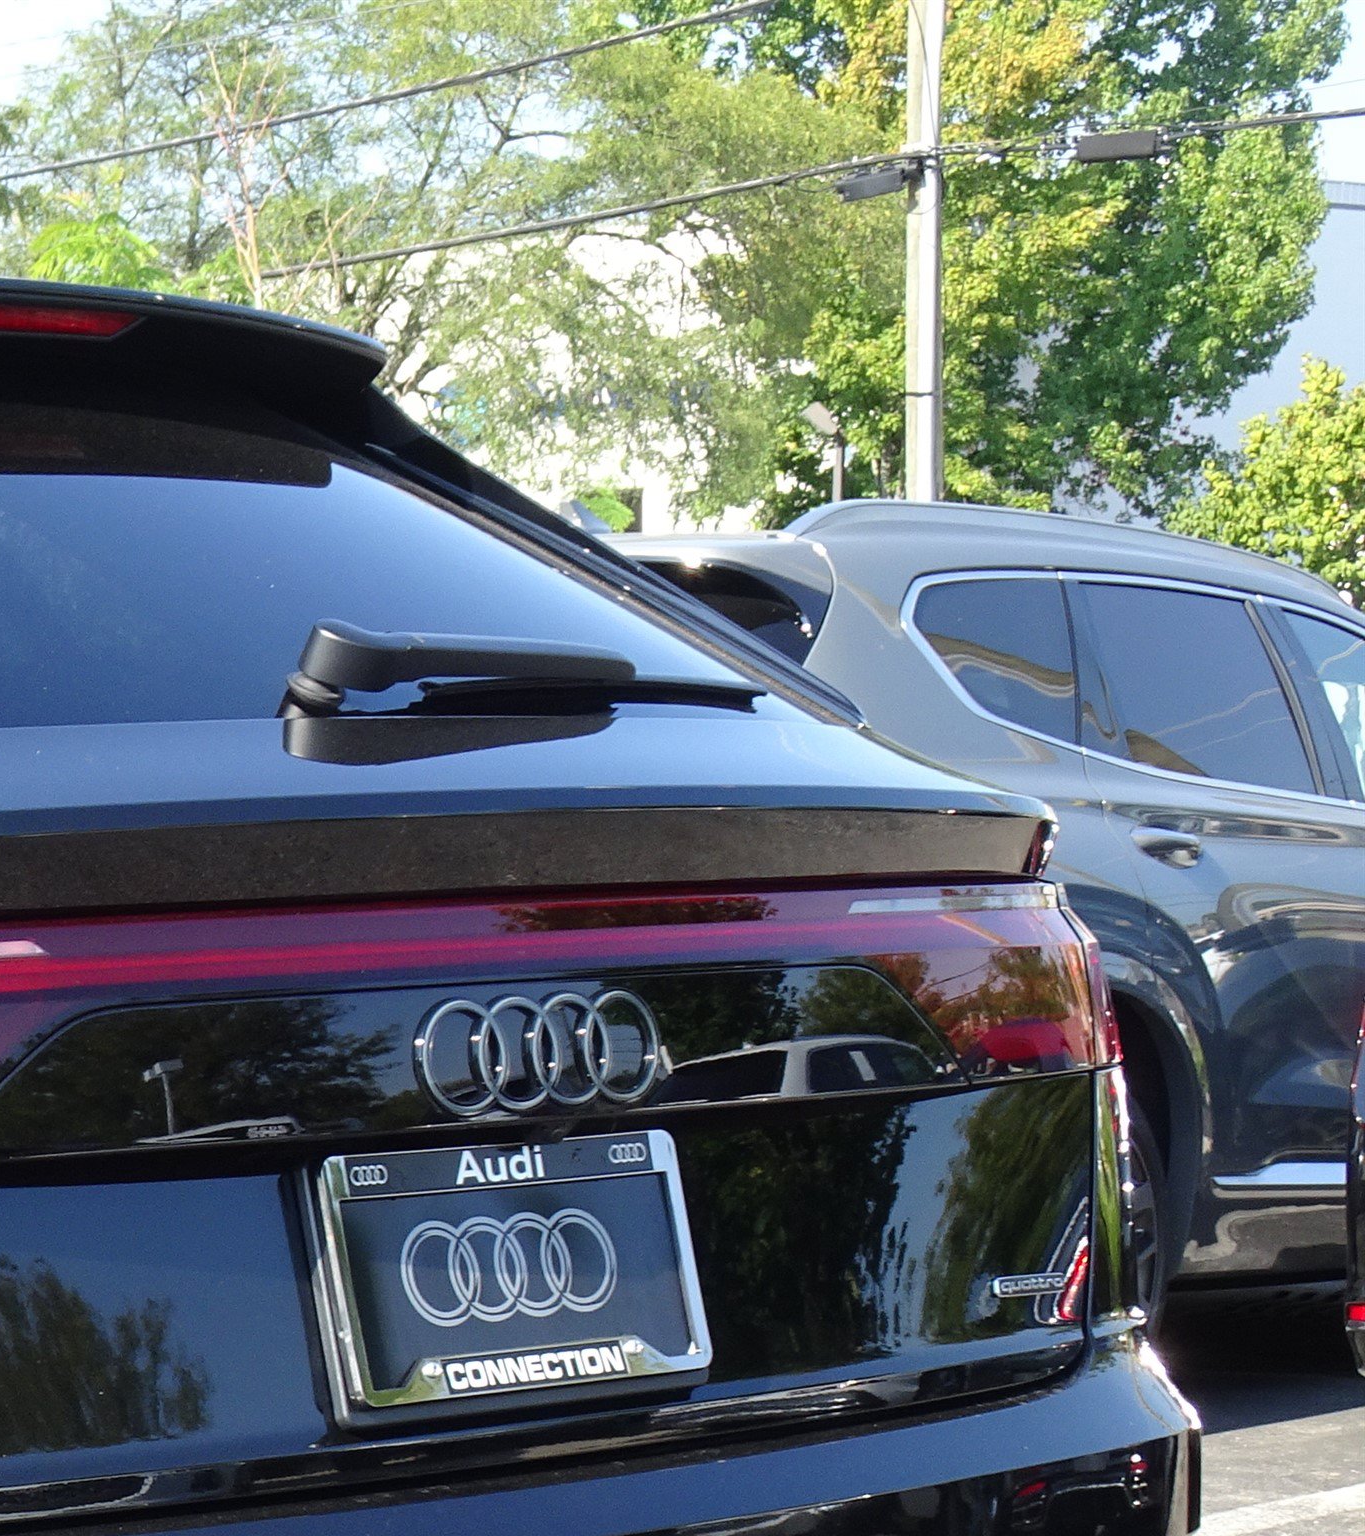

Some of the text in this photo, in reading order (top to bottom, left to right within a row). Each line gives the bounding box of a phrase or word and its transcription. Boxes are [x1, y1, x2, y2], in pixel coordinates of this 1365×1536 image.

[455, 1144, 545, 1186] Audi
[1001, 1277, 1065, 1293] quattro
[450, 1345, 625, 1392] CONNECTION
